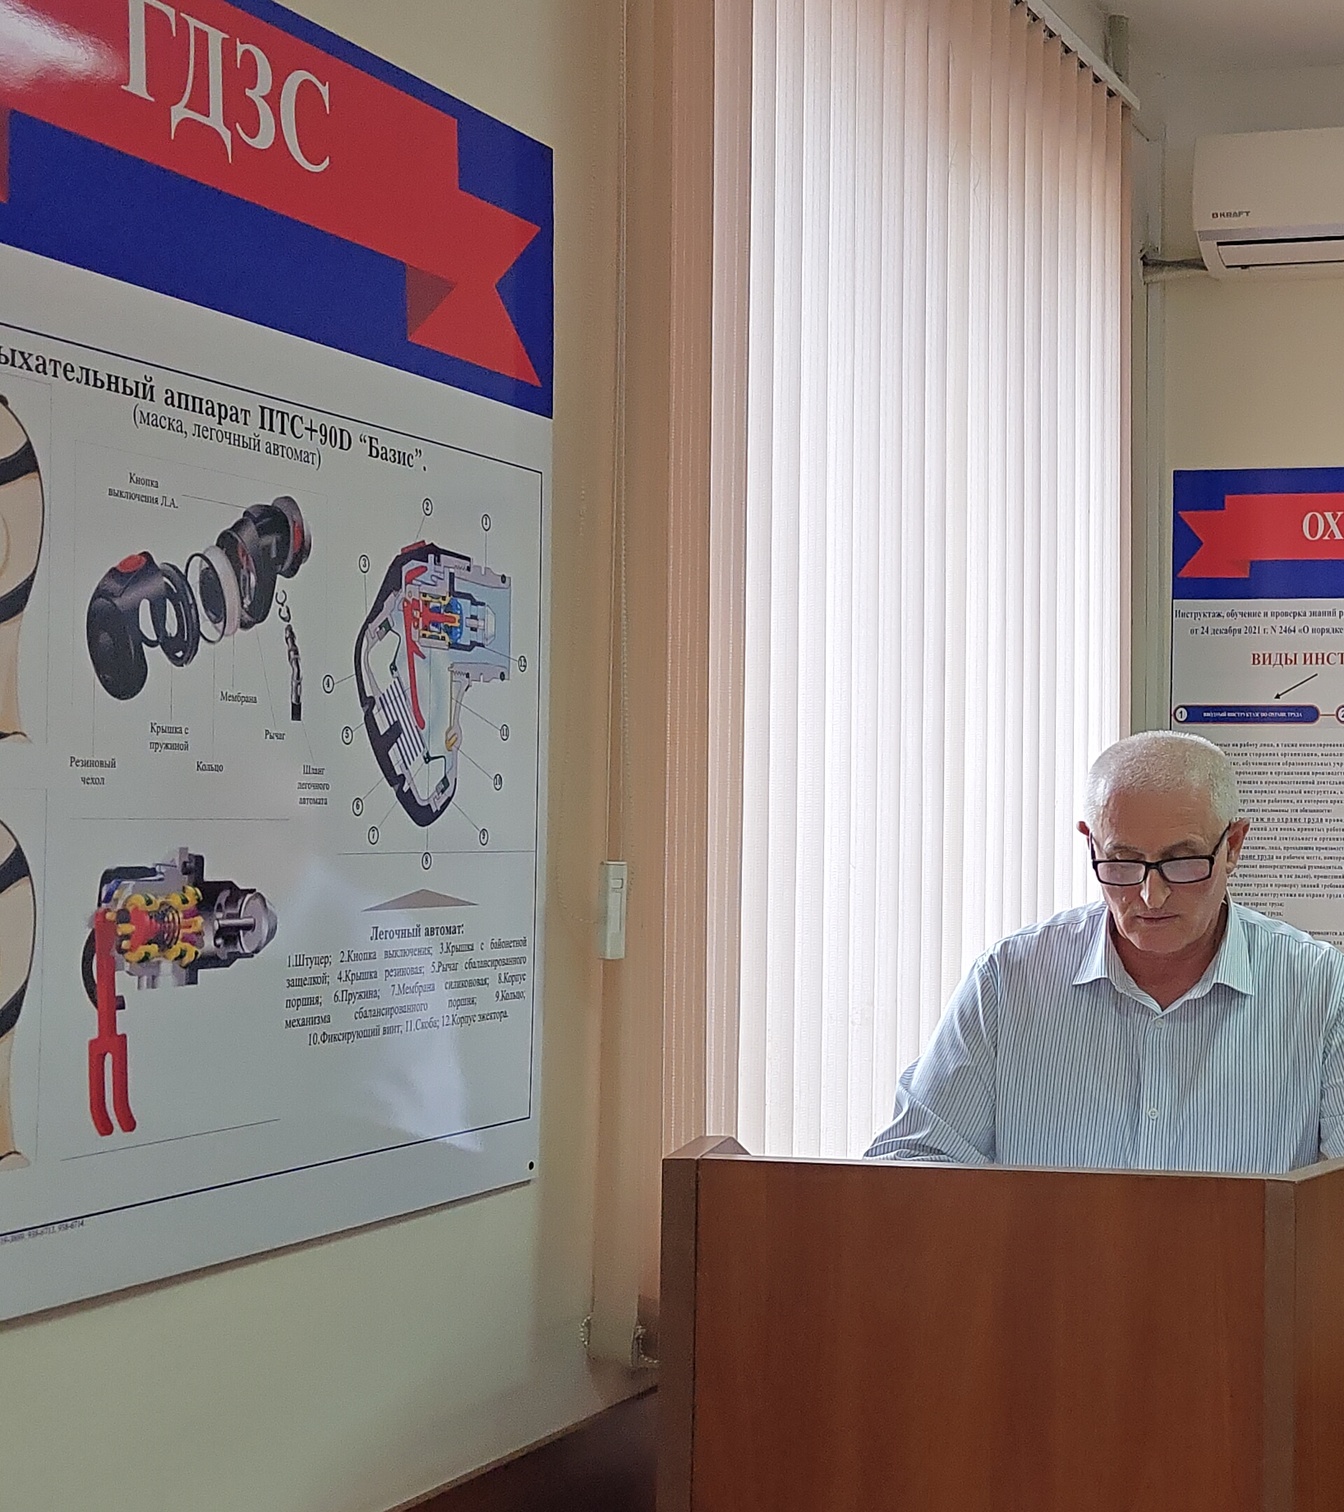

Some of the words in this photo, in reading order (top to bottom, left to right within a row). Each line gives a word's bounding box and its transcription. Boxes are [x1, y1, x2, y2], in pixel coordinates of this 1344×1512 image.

[121, 0, 330, 173] ГДЗС
[164, 388, 251, 426] аппарат
[257, 404, 353, 451] ПТС+90D
[132, 403, 188, 438] (маска,
[191, 422, 262, 453] легочный
[264, 442, 322, 470] автомат)
[129, 472, 159, 488] Кнопка
[108, 487, 159, 506] выключения
[1226, 609, 1261, 621] обучение
[1270, 610, 1306, 620] проверка
[1308, 608, 1336, 617] знаний
[1189, 628, 1198, 636] от
[1200, 626, 1209, 635] 24
[1210, 625, 1242, 637] декабря
[1243, 626, 1261, 635] 2021
[1270, 625, 1276, 634] N
[1278, 625, 1296, 634] 2464
[1251, 652, 1299, 668] ВИДЫ
[220, 690, 258, 705] Мембрана
[150, 722, 182, 738] Крышка
[184, 726, 189, 735] с
[149, 739, 189, 752] пружиной
[69, 756, 117, 769] Резиновый
[196, 760, 224, 773] Кольцо
[81, 775, 105, 786] чехол
[370, 924, 421, 941] Легочный
[424, 924, 464, 937] автомат:
[287, 953, 332, 970] 1.Штуцер;
[339, 949, 377, 963] 2.Кнопка
[286, 972, 330, 988] защелкой;
[337, 969, 378, 985] 4.Крышка
[285, 995, 323, 1011] поршня;
[333, 989, 380, 1005] 6.Пружина;
[284, 1014, 331, 1030] механизма
[353, 1002, 429, 1021] сбалансированного
[308, 1023, 381, 1046] 10.Фиксирующий
